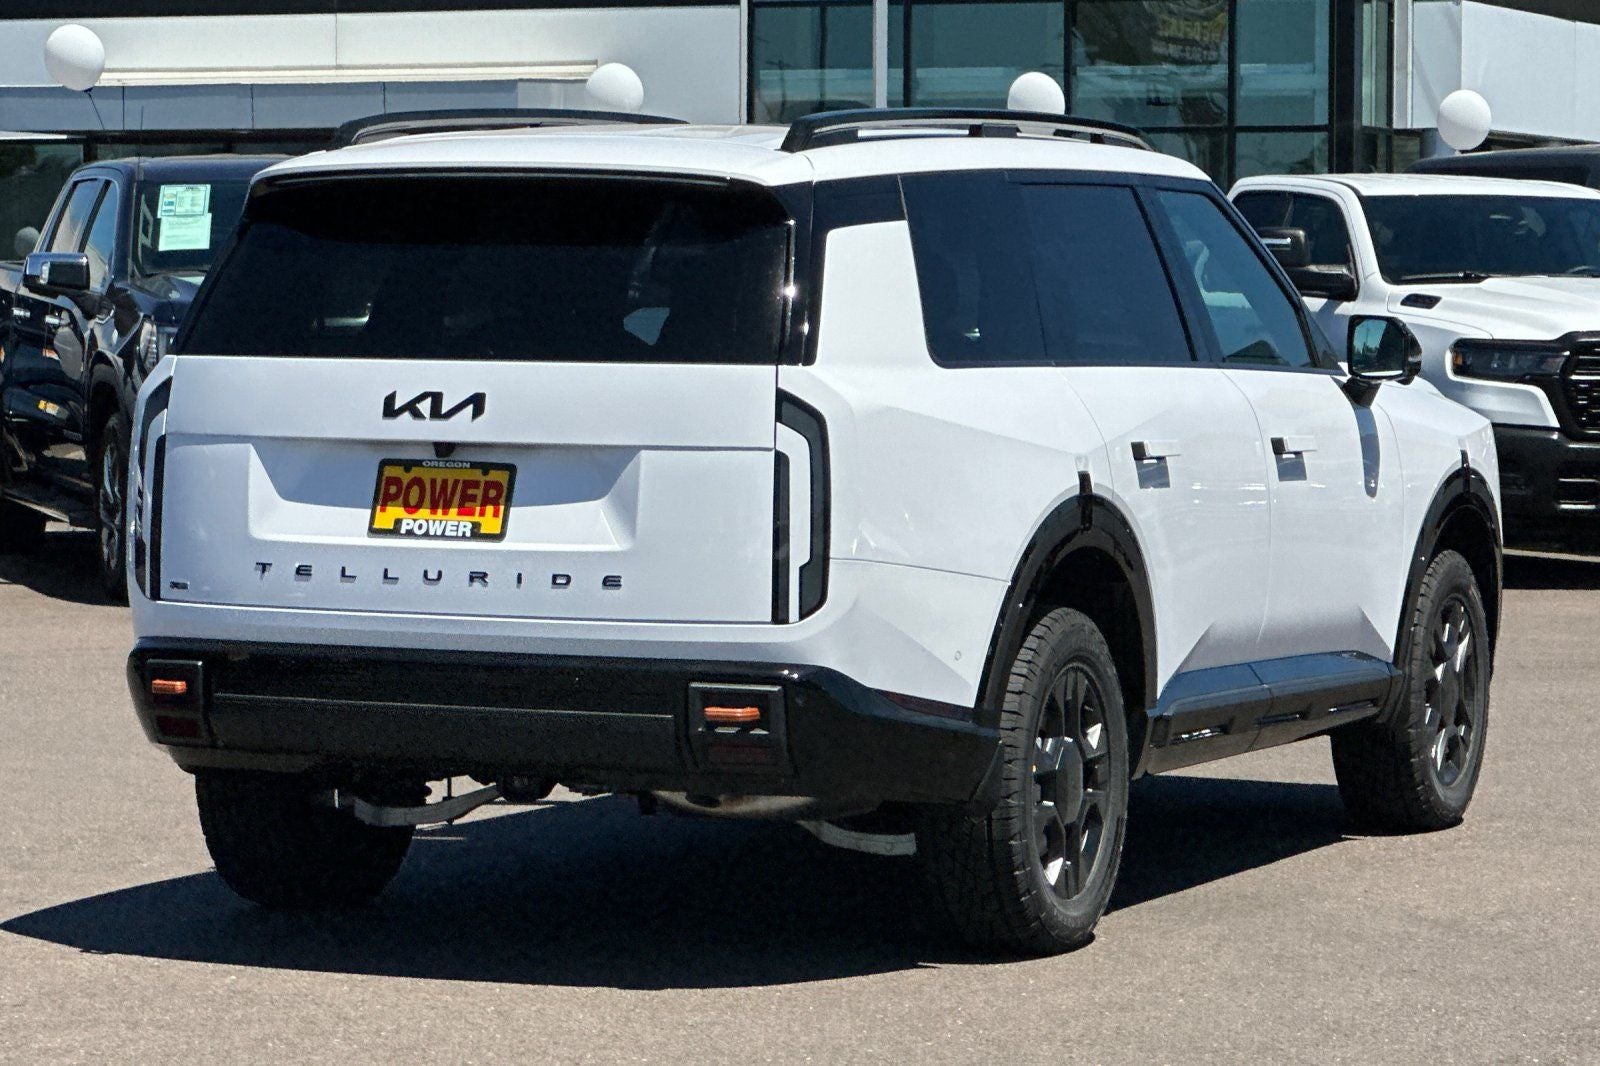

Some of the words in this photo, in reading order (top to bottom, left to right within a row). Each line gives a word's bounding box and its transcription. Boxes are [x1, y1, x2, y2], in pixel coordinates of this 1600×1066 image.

[382, 390, 486, 422] KIA
[422, 460, 471, 469] OREGON
[379, 476, 505, 518] POWER
[400, 518, 473, 538] POWER
[255, 562, 622, 588] TELLURIDE
